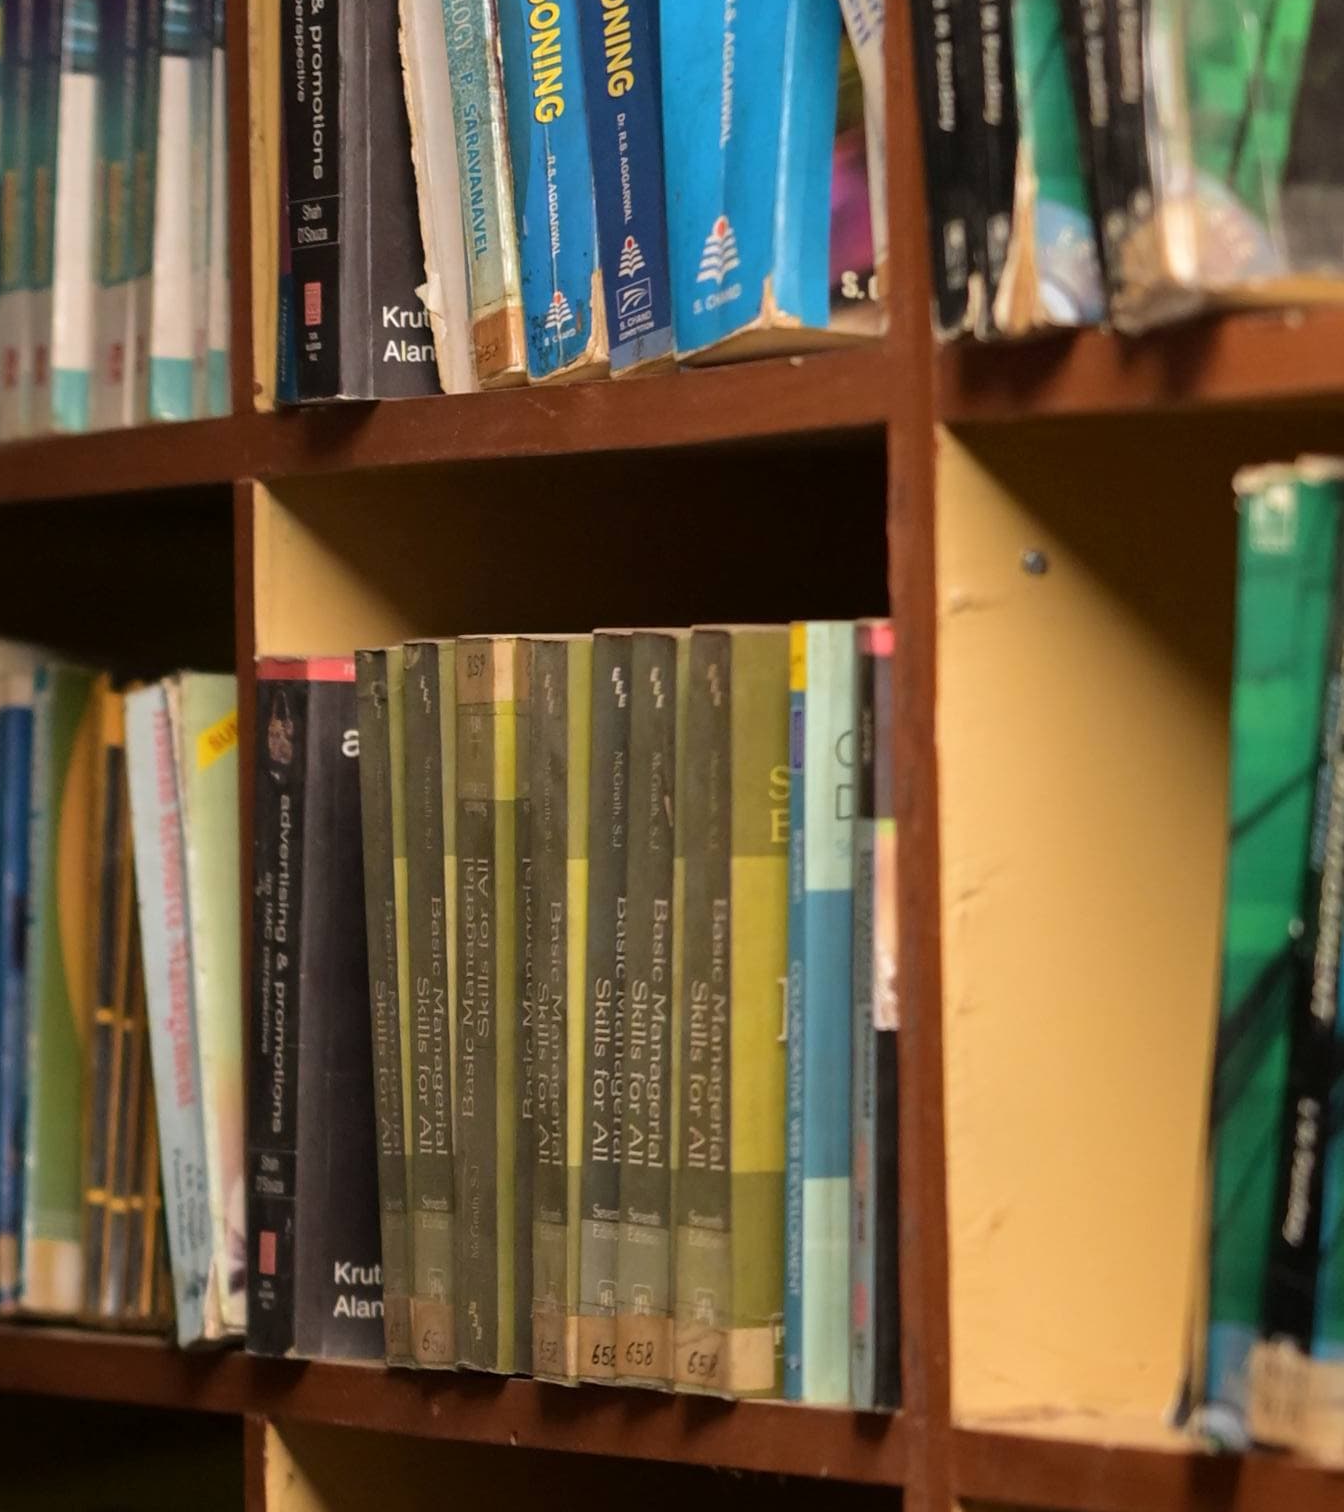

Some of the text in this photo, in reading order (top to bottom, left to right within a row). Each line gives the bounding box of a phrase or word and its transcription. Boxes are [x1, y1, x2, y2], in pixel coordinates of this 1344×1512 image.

[309, 25, 326, 180] promotions
[462, 101, 489, 261] SARAVANAVEL
[548, 183, 562, 259] AGGARWAL
[619, 156, 633, 225] AGGARWAL
[382, 340, 435, 362] Alan
[275, 793, 293, 943] advertising
[430, 896, 449, 1156] Basic Managerial
[461, 856, 476, 1118] Basic Managerial
[476, 858, 490, 1039] Skills for All
[272, 976, 287, 1134] promotions
[416, 975, 432, 1155] Skills for All
[591, 977, 612, 1163] Skills for All
[627, 980, 649, 1166] Skills for All
[645, 898, 669, 1170] Basic Managerial
[687, 980, 710, 1168] Skills for All
[708, 898, 729, 1172] Basic Managerial
[332, 1296, 384, 1318] Alan
[333, 1261, 383, 1286] Krut
[625, 1341, 654, 1366] 658
